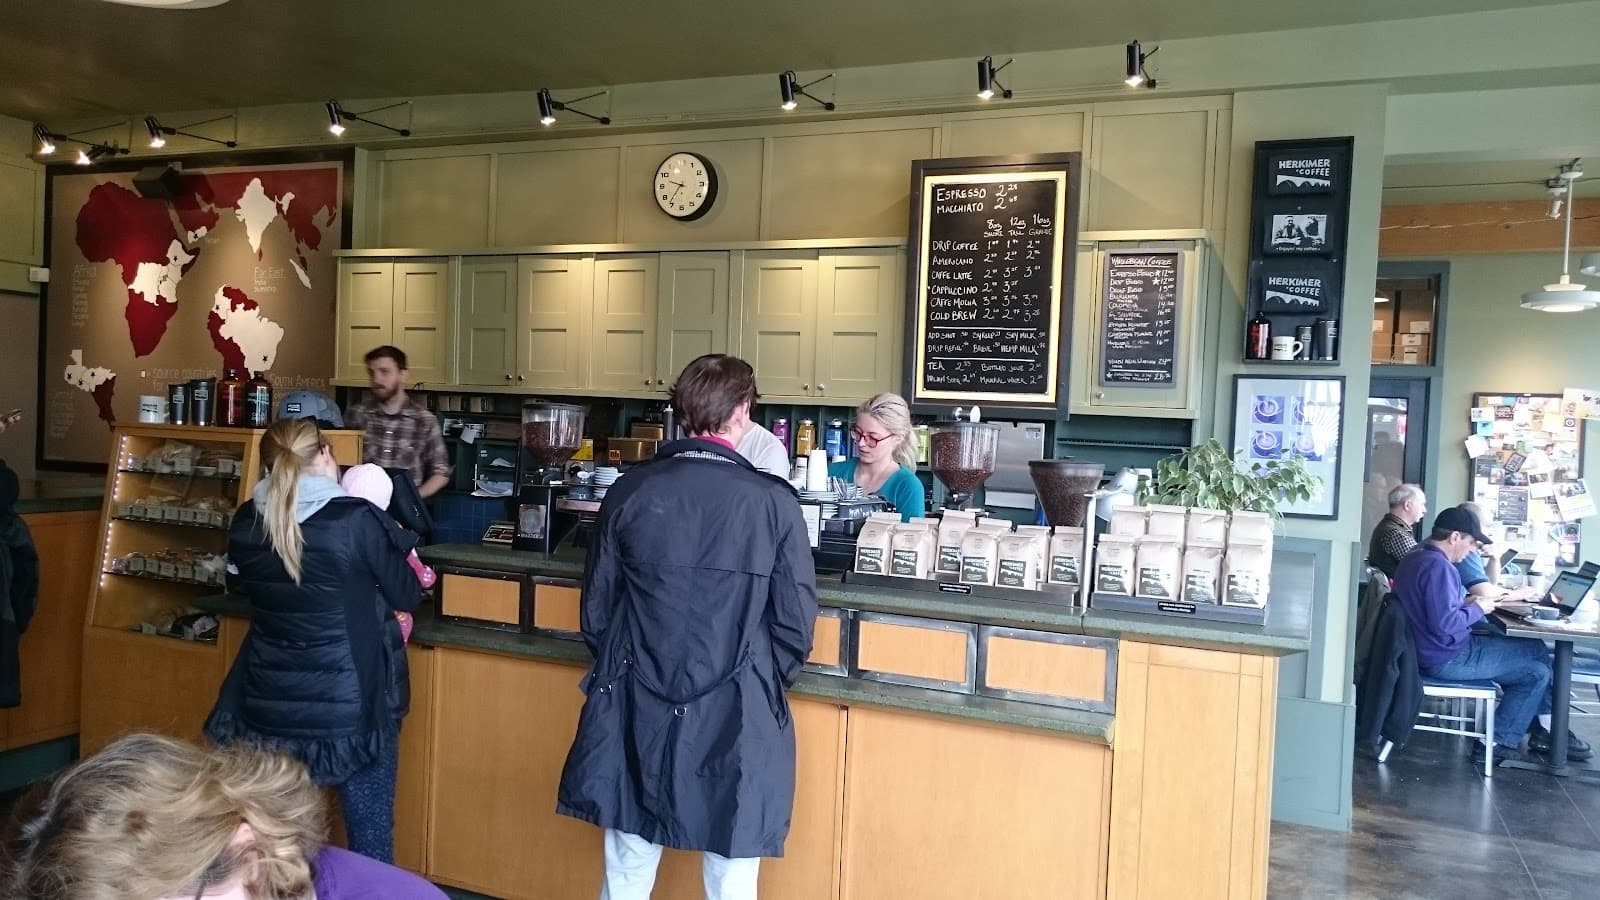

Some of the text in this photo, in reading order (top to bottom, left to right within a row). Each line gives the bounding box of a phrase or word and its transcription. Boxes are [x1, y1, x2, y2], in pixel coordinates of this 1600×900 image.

[1278, 159, 1330, 169] HERKIMER
[1299, 168, 1330, 177] COFFEE
[937, 188, 986, 201] ESPRESSO
[937, 202, 984, 214] MACCHIATO
[932, 240, 952, 251] DRIP
[952, 241, 979, 251] COFFEE
[932, 256, 973, 266] AMERICANO
[931, 270, 951, 280] CAFFE
[953, 271, 973, 280] LATTE
[1269, 277, 1321, 287] HERKIMER
[931, 286, 978, 295] CAPPUCCINO
[1289, 287, 1320, 297] COFFEE
[930, 298, 951, 307] CAFFE
[953, 298, 977, 309] MOCHA
[930, 311, 950, 320] COLD
[952, 309, 977, 321] BREW
[928, 362, 946, 371] TEA
